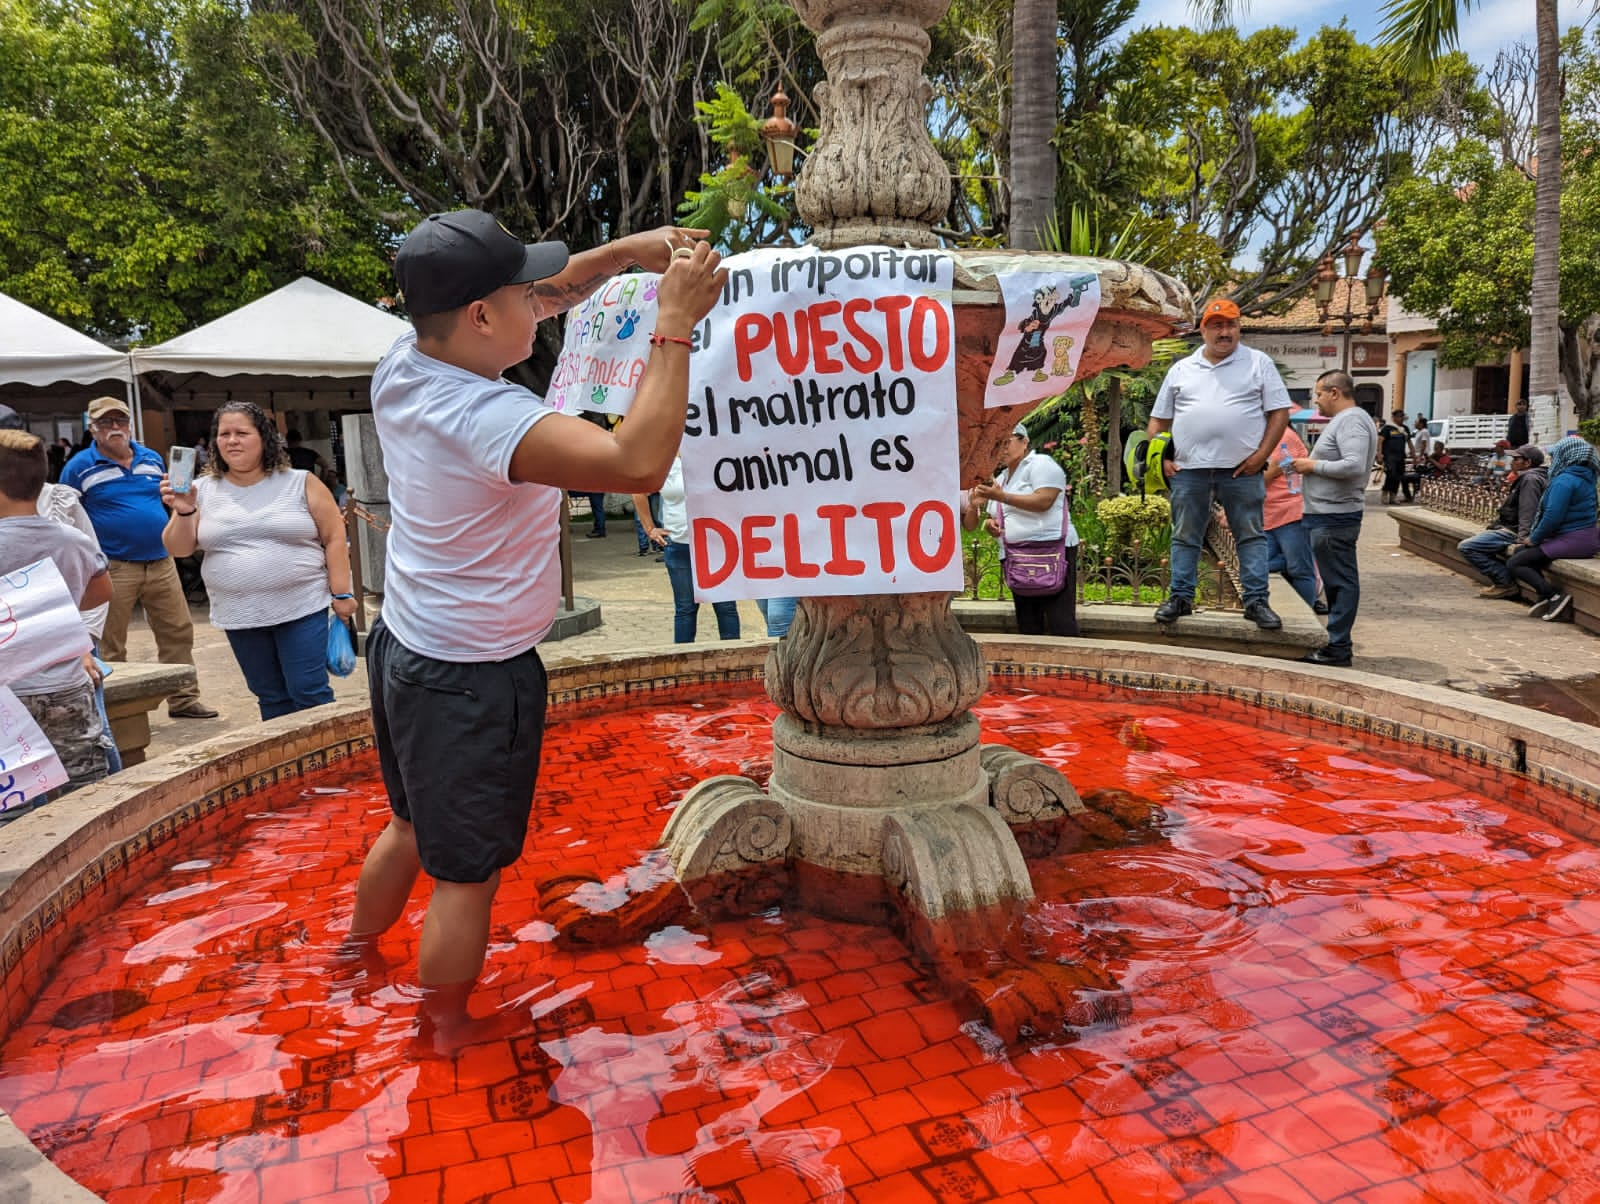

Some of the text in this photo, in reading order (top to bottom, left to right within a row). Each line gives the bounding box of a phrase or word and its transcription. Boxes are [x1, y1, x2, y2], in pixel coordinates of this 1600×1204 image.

[723, 249, 948, 305] in importar
[734, 295, 950, 382] PUESTO
[684, 373, 915, 437] el maltrato
[714, 433, 914, 492] animal es
[693, 500, 955, 589] DELITO
